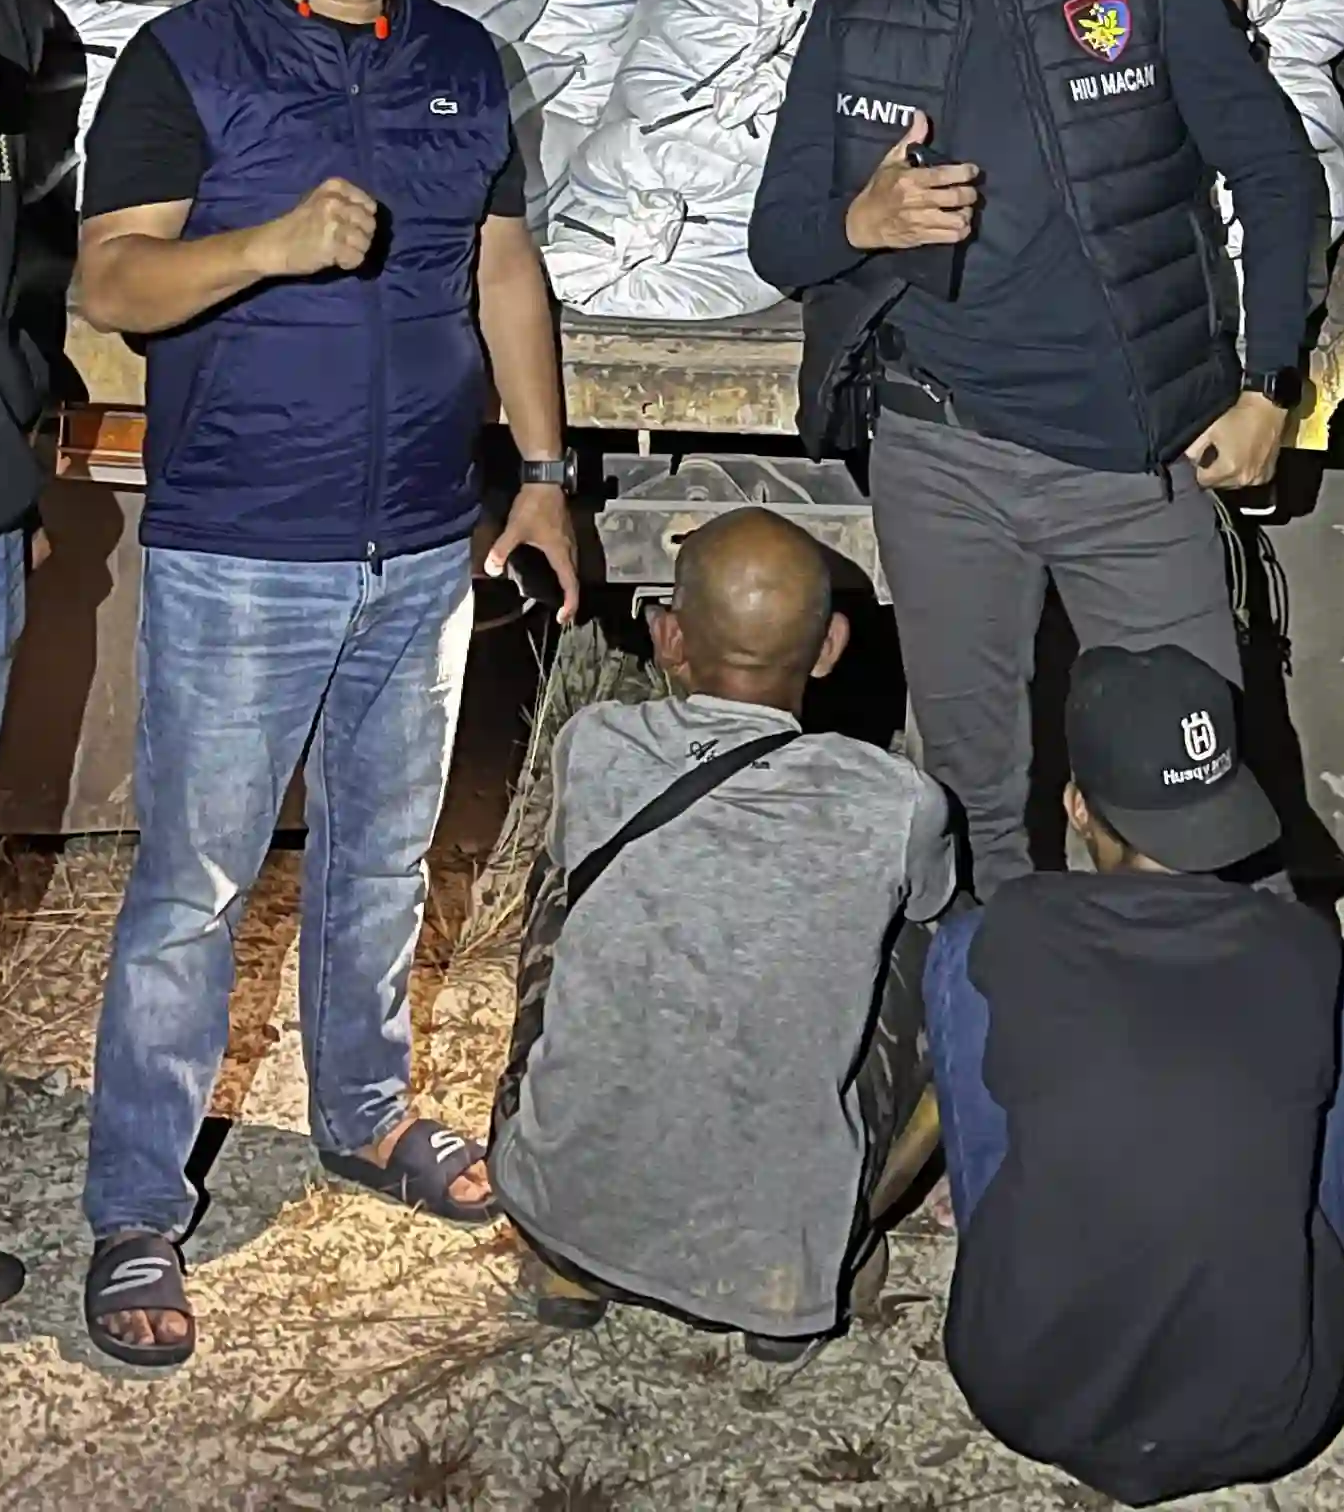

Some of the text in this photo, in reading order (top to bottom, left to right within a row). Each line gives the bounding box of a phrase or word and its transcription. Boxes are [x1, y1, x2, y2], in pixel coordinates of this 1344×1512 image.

[1069, 63, 1156, 102] HIU MACAN
[836, 91, 916, 127] KANIT
[1163, 748, 1233, 786] Husqv
